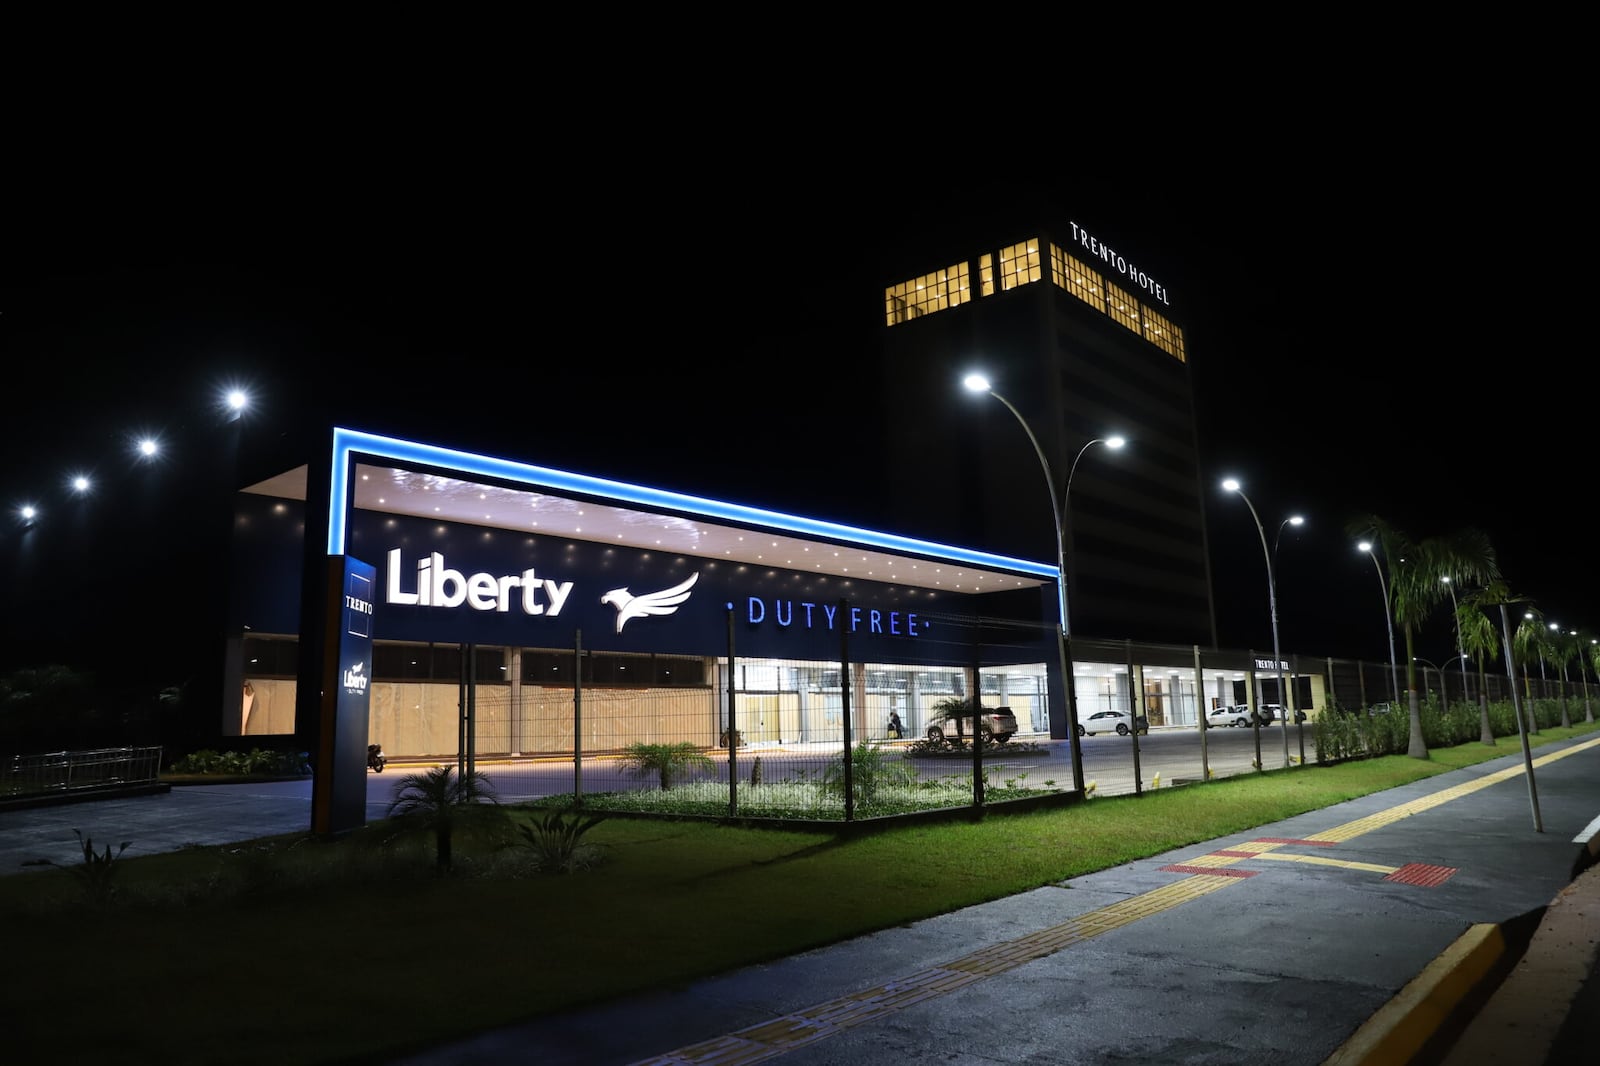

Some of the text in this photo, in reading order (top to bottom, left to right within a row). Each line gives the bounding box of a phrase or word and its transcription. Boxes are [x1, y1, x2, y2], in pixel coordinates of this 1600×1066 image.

[1070, 221, 1169, 305] TRENTO HOTEL
[386, 548, 574, 616] Liberty
[345, 595, 373, 615] TRENTO
[748, 597, 918, 636] DUTY FREE
[1255, 659, 1289, 670] TRENTO HTEL
[343, 670, 368, 689] Liberty
